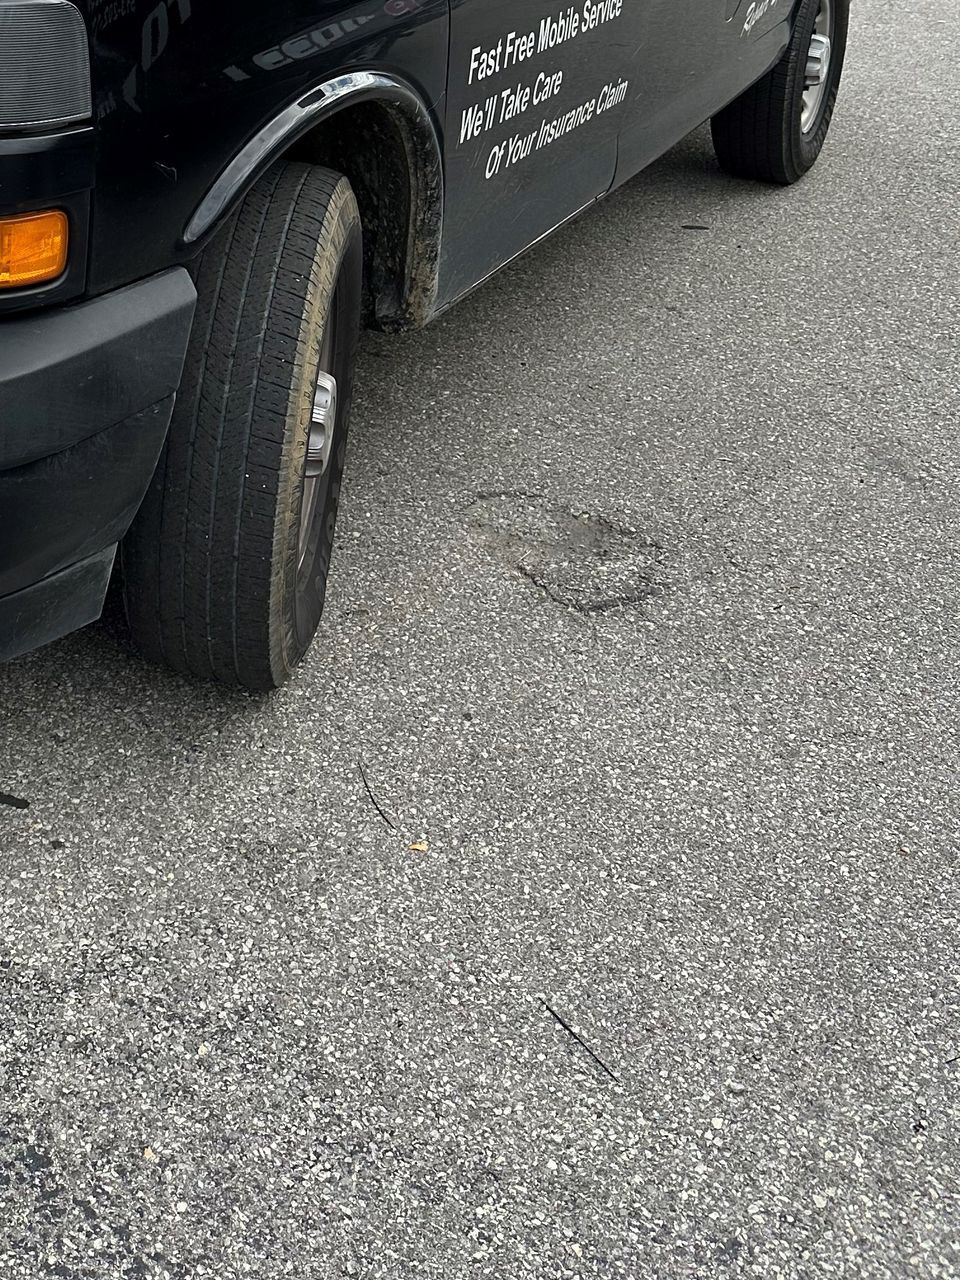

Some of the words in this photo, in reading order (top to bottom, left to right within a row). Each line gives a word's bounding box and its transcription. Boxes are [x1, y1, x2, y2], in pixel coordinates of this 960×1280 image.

[468, 38, 503, 85] Fast
[503, 31, 536, 69] Free
[536, 6, 579, 54] Mobile
[459, 94, 498, 144] We'll
[499, 83, 531, 124] Take
[532, 70, 563, 106] Care
[485, 140, 507, 180] Of
[505, 130, 538, 168] Your
[535, 98, 596, 151] Insurance
[596, 78, 629, 115] Claim
